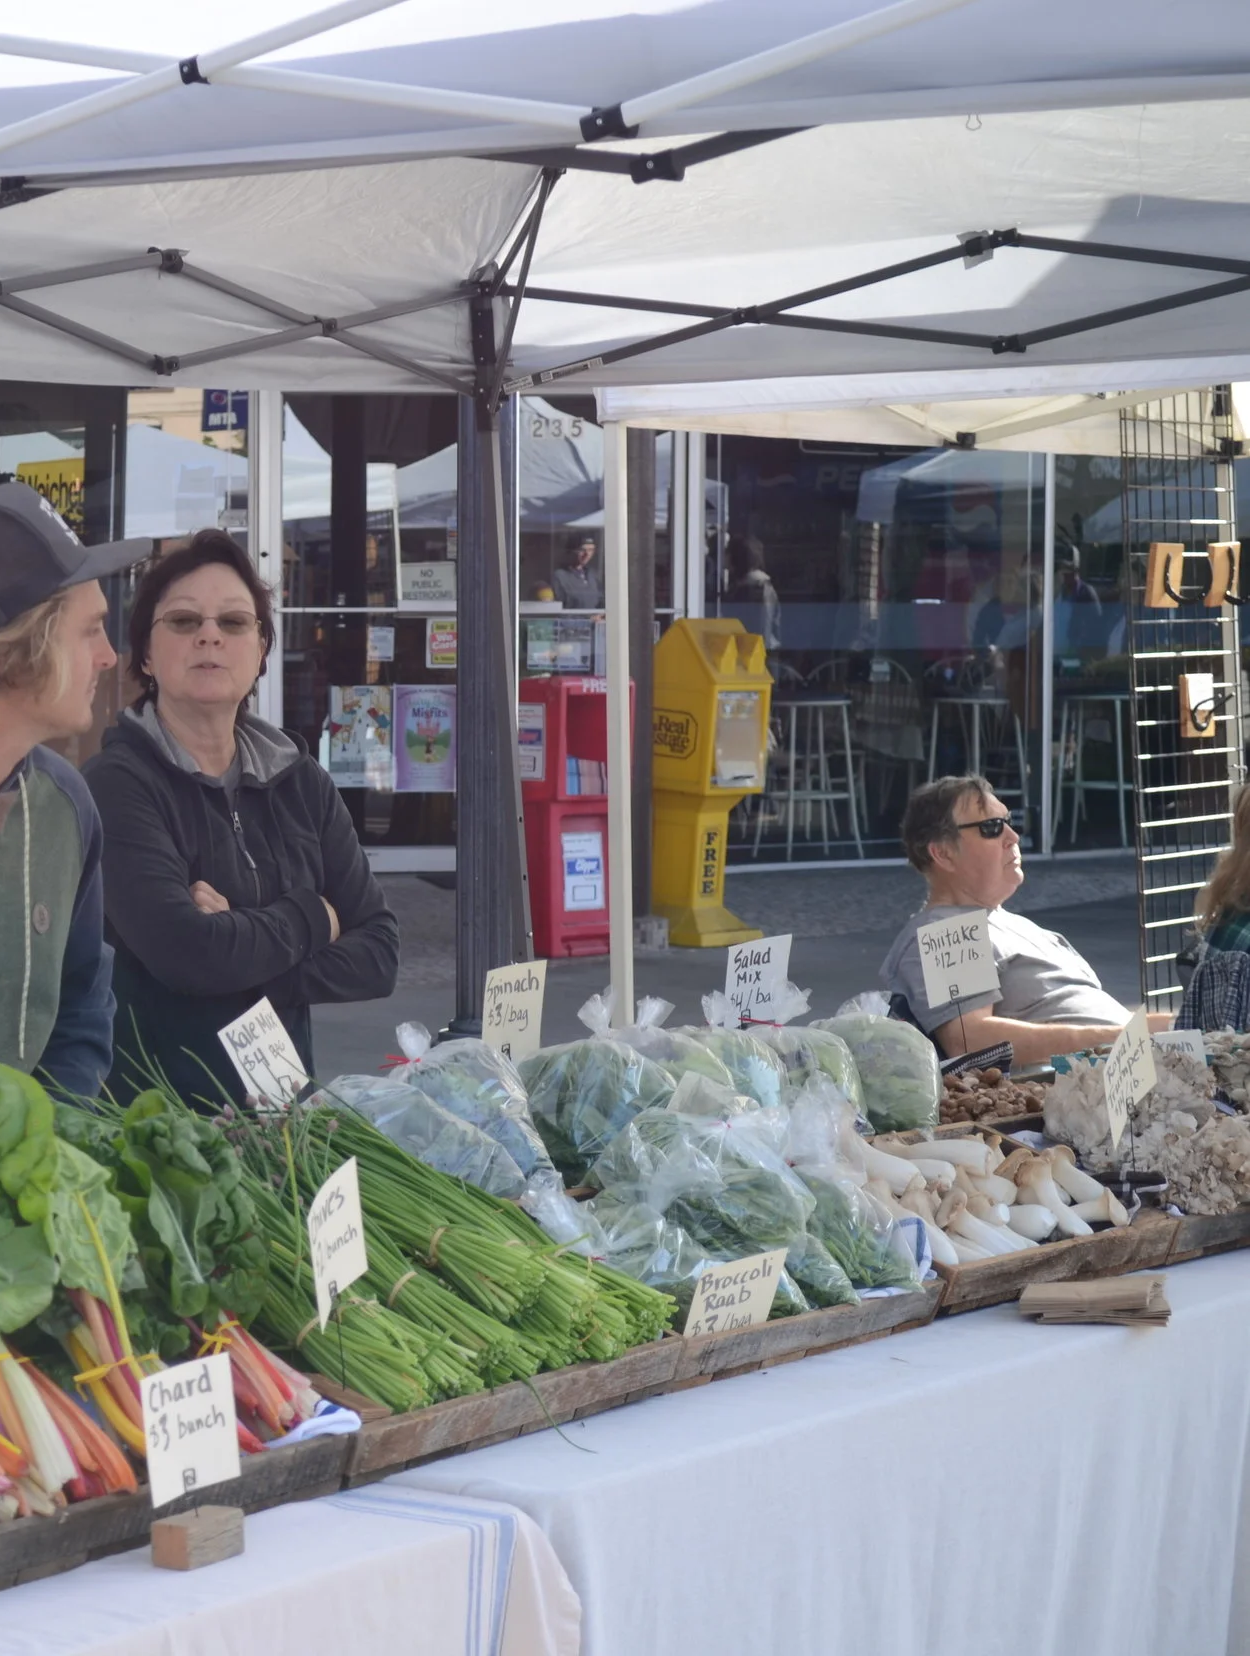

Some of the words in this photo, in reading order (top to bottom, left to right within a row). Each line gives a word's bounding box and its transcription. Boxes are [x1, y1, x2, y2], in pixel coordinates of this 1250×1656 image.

[532, 419, 582, 438] 235
[411, 579, 442, 589] PUBLIC
[419, 568, 434, 578] NO
[582, 678, 607, 693] FRE
[411, 707, 448, 719] Misfits
[658, 715, 690, 735] Real
[653, 731, 690, 751] state
[701, 831, 718, 895] FREE
[921, 924, 979, 955] Shiitake
[734, 946, 771, 973] Salad
[487, 969, 539, 1005] Spinach
[731, 987, 771, 1011] $4/ba
[225, 1021, 260, 1051] Kale
[244, 1047, 271, 1072] $4
[1108, 1037, 1146, 1109] Trumpet
[327, 1224, 358, 1259] bunch
[700, 1257, 774, 1295] Broccoli
[703, 1286, 752, 1313] Raab
[149, 1363, 212, 1412] Chard
[149, 1413, 170, 1452] $3
[177, 1404, 226, 1440] bunch
